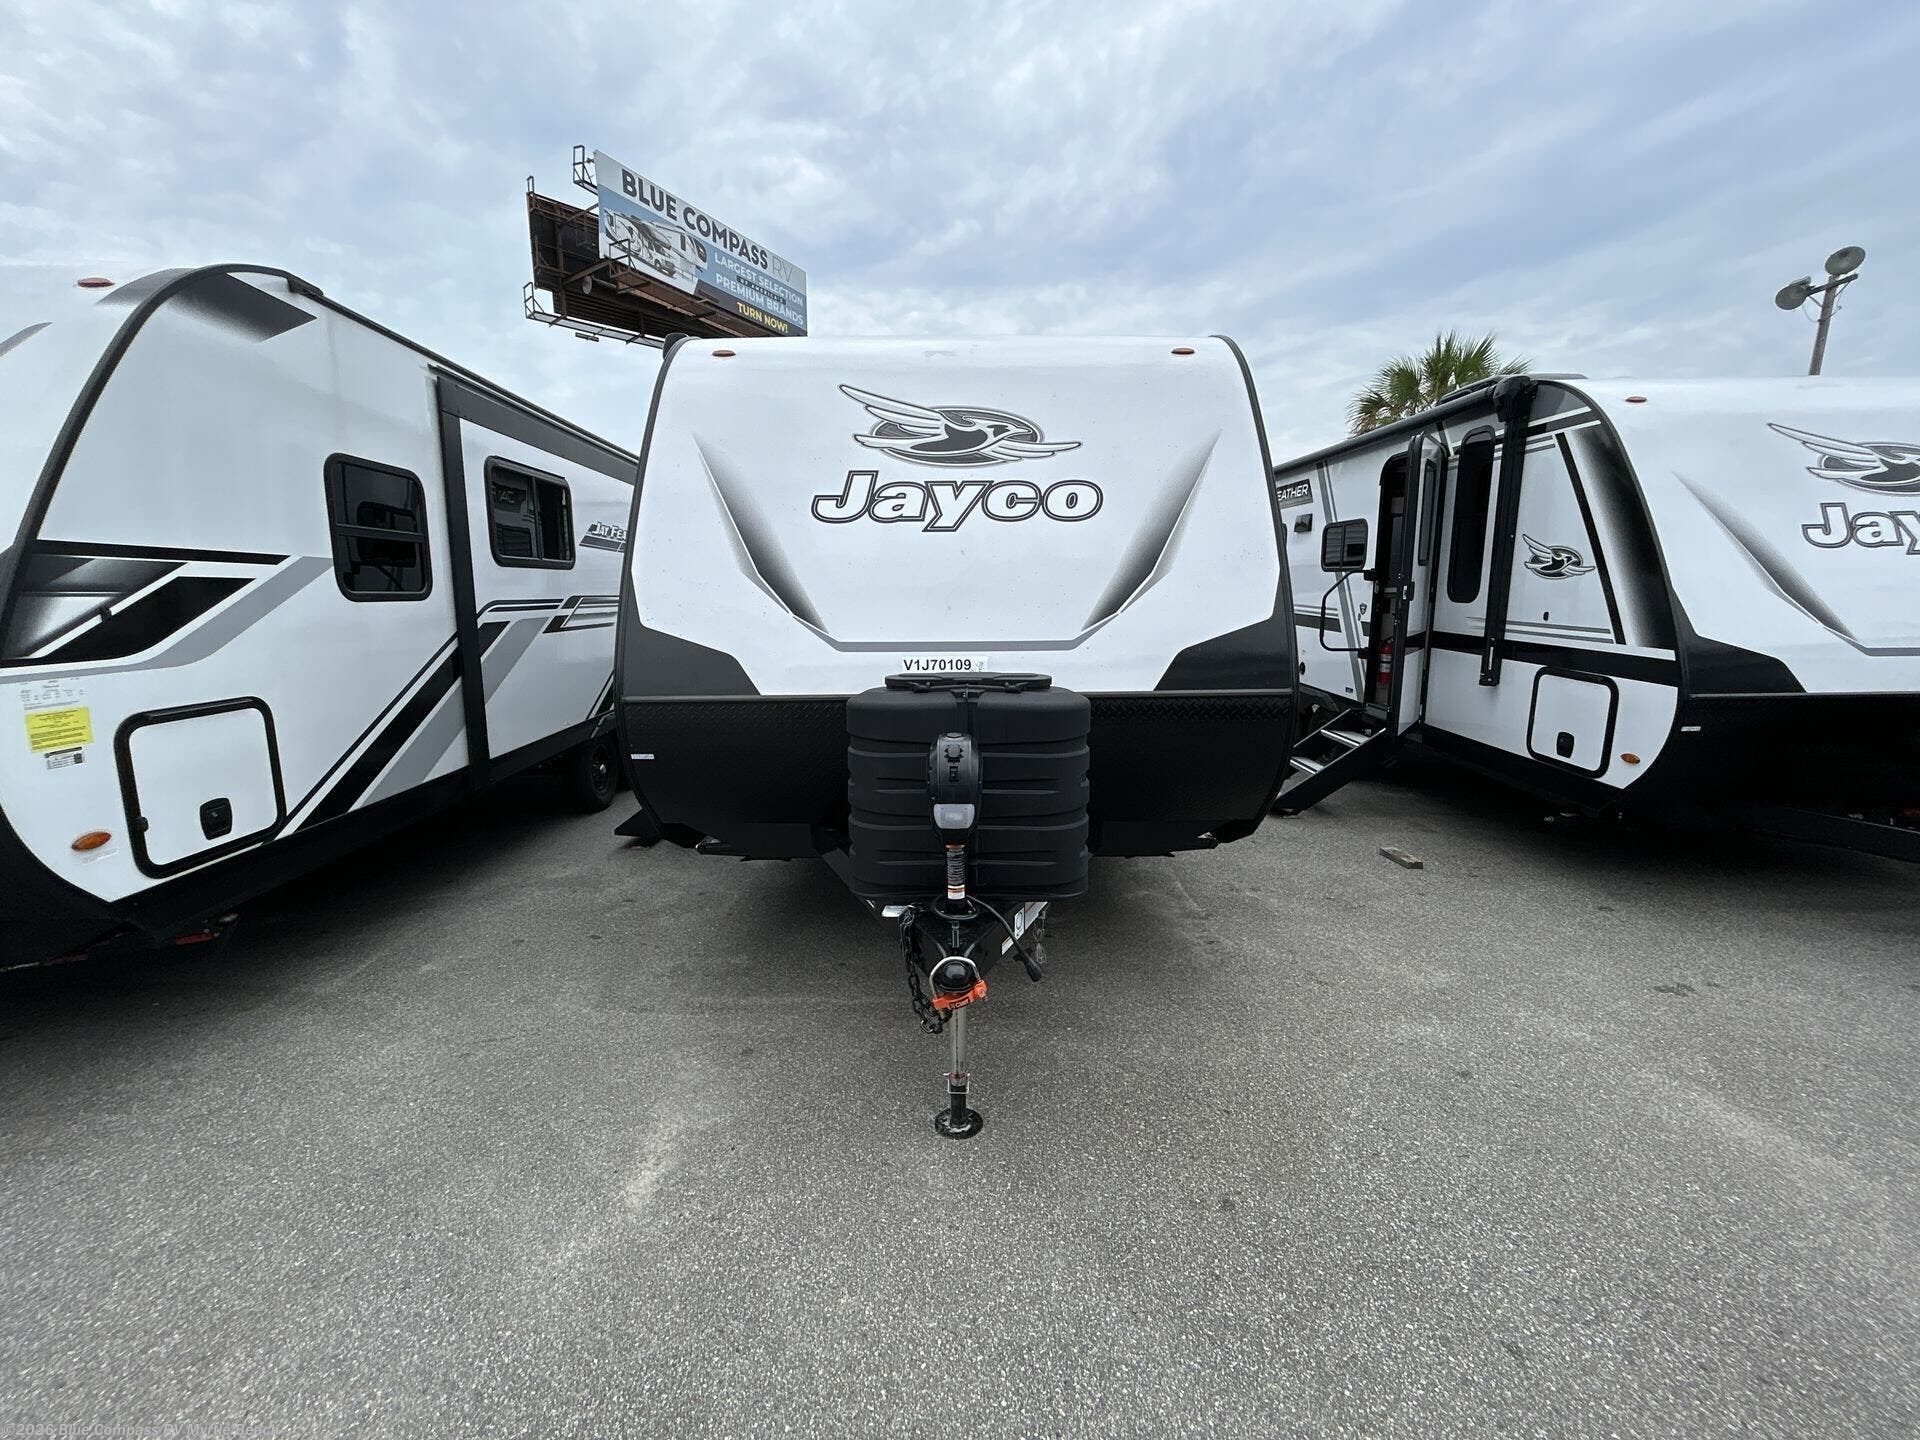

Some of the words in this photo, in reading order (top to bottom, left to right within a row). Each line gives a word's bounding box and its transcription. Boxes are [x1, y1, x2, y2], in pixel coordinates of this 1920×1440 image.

[621, 168, 677, 221] BLUE
[683, 206, 768, 270] COMPASS
[772, 256, 793, 283] RV
[714, 252, 757, 282] LARGEST
[759, 276, 803, 307] SELECTION
[716, 273, 764, 306] PREMIUM
[767, 300, 804, 325] BRANDS
[736, 302, 763, 322] TURN
[764, 315, 788, 333] NOW!
[811, 470, 1104, 532] Jayco
[903, 658, 972, 671] V1J70109
